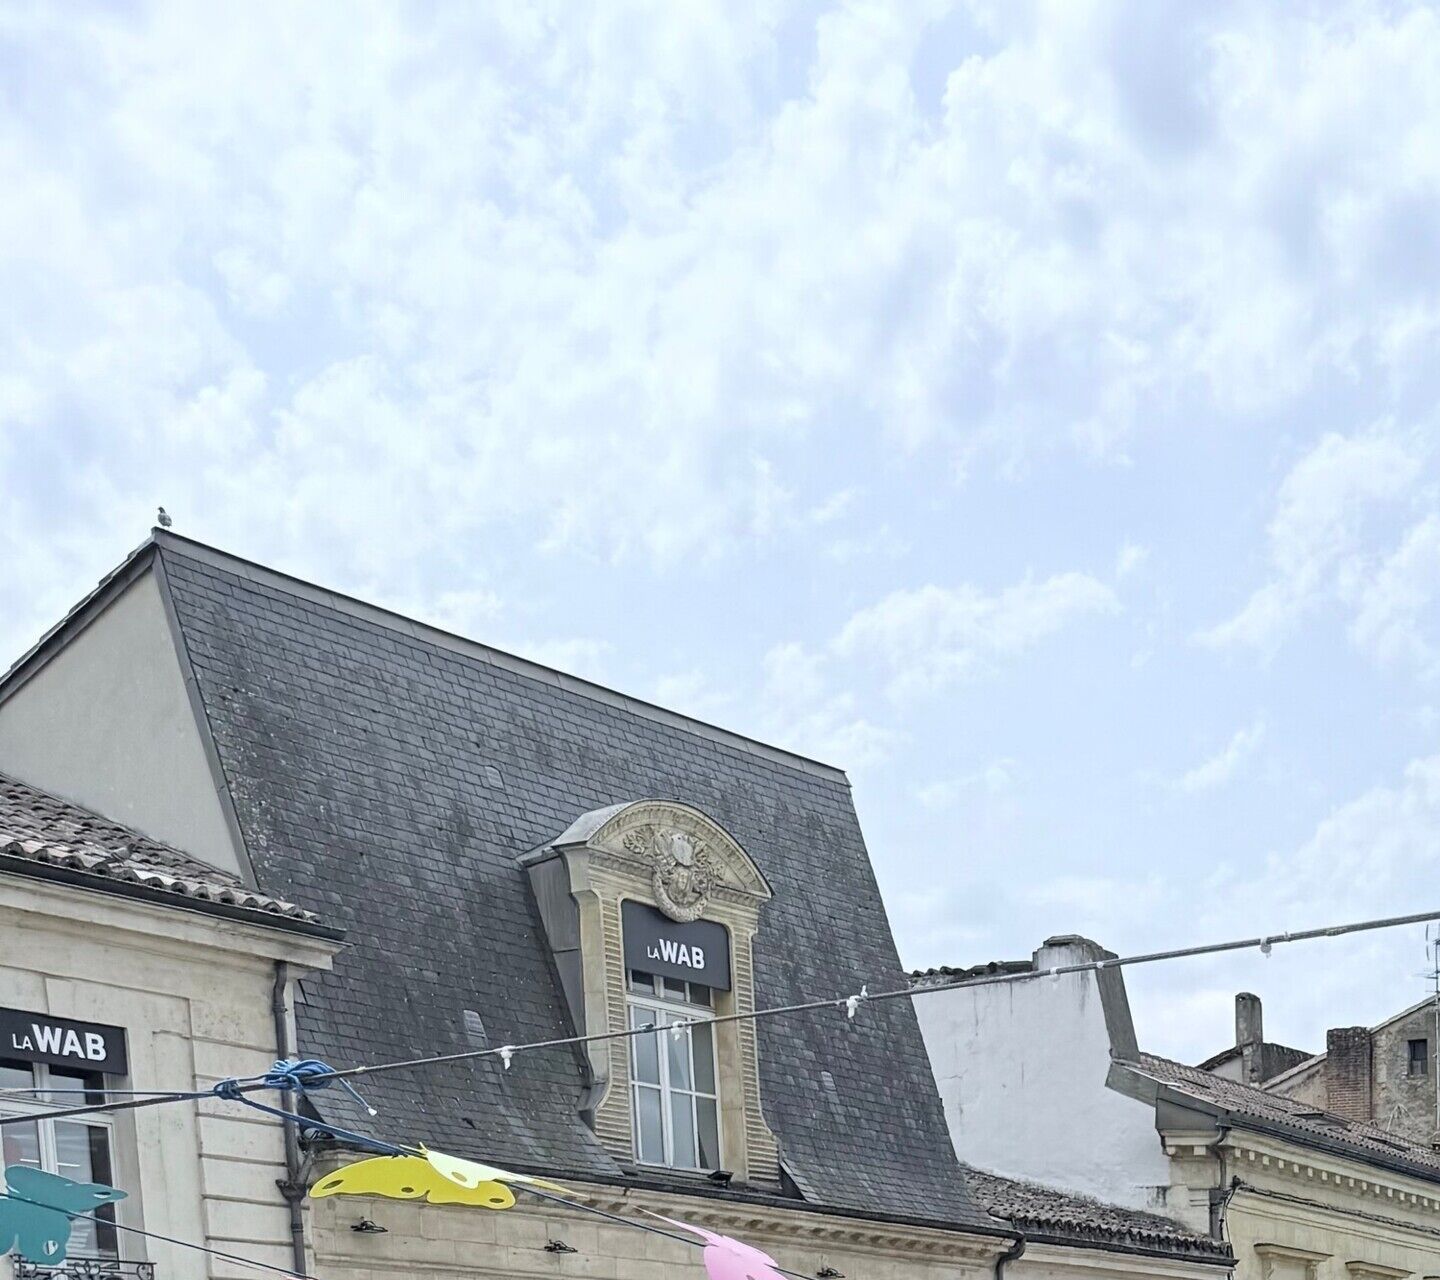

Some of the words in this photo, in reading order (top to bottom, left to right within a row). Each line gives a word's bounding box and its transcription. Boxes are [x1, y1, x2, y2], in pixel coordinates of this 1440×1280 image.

[647, 946, 660, 960] LA
[659, 938, 705, 969] WAB
[12, 1033, 33, 1051] LA
[31, 1023, 107, 1061] WAB
